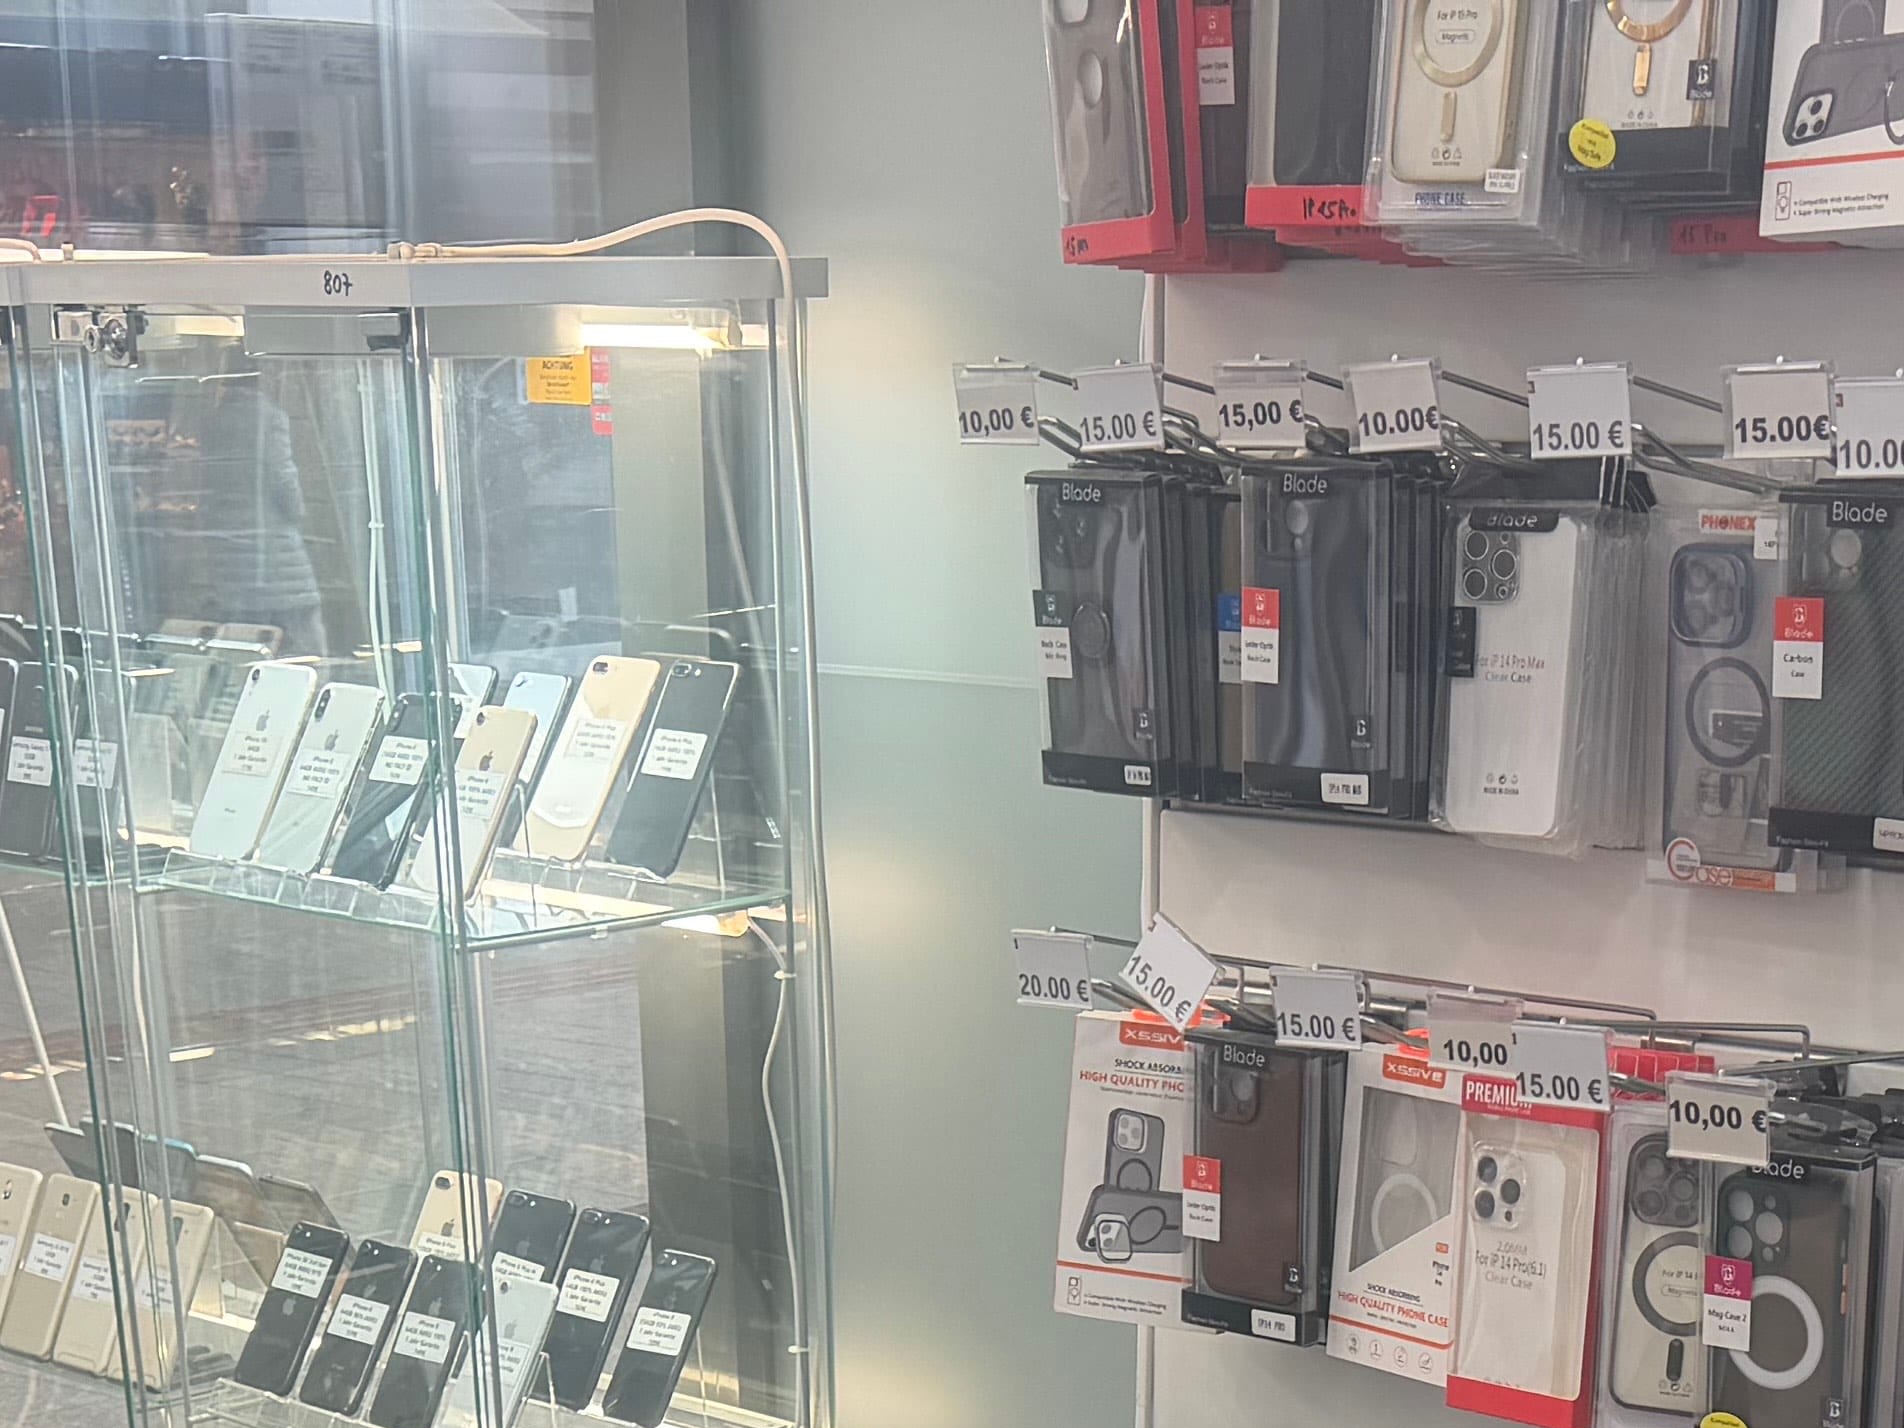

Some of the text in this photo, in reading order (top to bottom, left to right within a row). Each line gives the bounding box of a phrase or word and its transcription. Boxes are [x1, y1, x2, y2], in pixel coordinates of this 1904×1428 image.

[959, 406, 1034, 435] 10,00 €
[1081, 411, 1157, 442] 15.00 €
[1219, 401, 1303, 430] 15,00 €
[1533, 420, 1623, 451] 15.00 €
[1062, 484, 1100, 502] Blade
[1832, 503, 1887, 523] Blade
[1019, 974, 1089, 1001] 20.00 €
[1127, 954, 1191, 1021] 15.00 €
[1277, 1013, 1356, 1041] 15.00 €
[1223, 1045, 1265, 1067] Blade
[1444, 1041, 1507, 1065] 10,00
[1517, 1070, 1603, 1104] 15.00 €
[1362, 1296, 1394, 1314] QUALITY
[1396, 1303, 1424, 1321] PHONE
[1426, 1313, 1449, 1328] CASE
